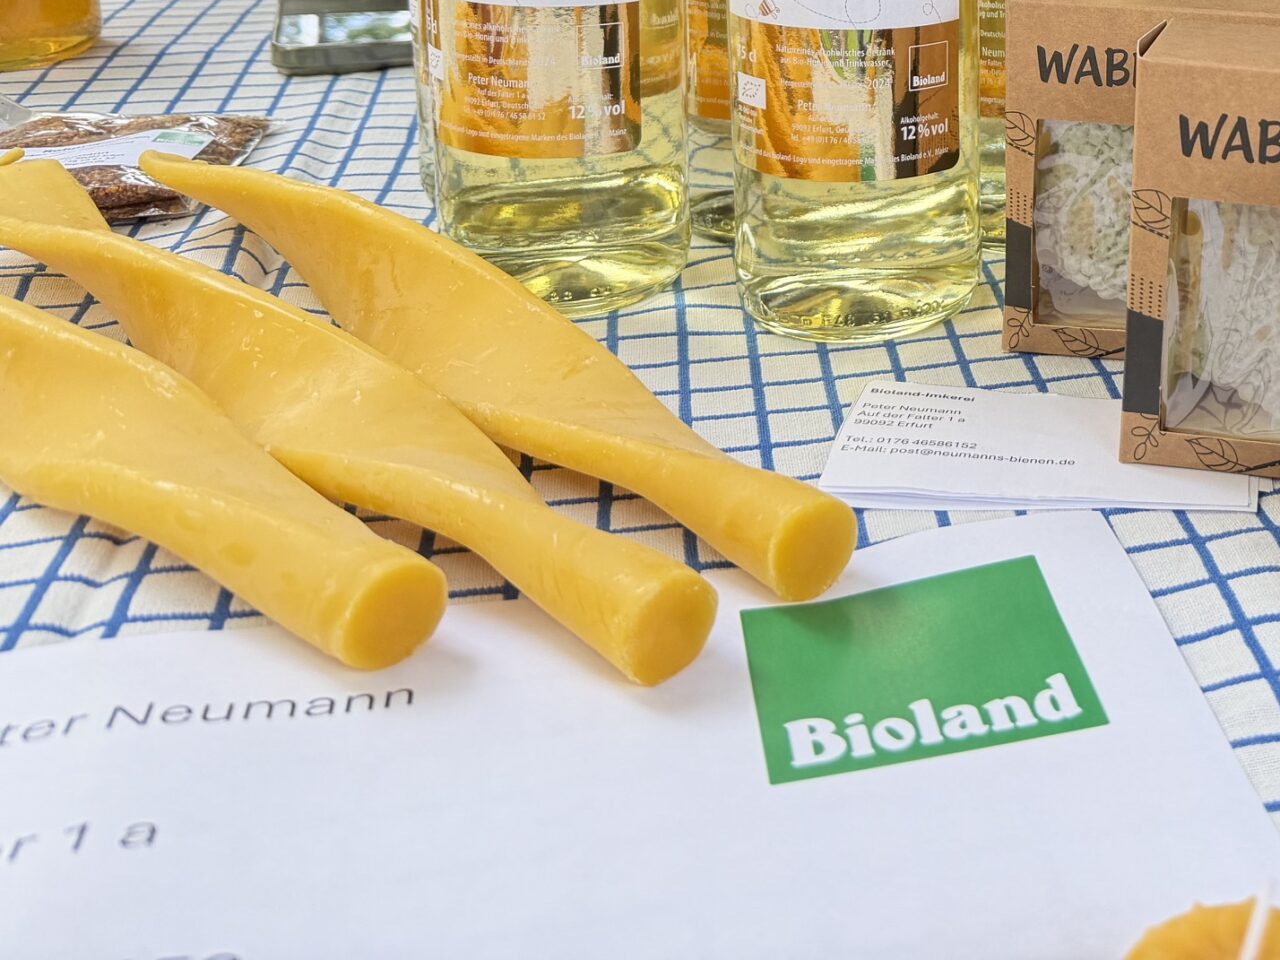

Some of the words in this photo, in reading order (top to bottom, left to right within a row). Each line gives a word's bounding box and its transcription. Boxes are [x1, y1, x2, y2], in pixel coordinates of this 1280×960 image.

[982, 46, 1006, 58] Neum
[1037, 43, 1137, 88] WAB
[468, 72, 489, 86] Peter
[491, 75, 530, 89] Neuman
[911, 71, 946, 88] Bioland
[604, 99, 626, 116] vol
[931, 118, 949, 136] vol
[901, 152, 922, 162] Bioland
[870, 388, 975, 402] Bioland-Imkerei
[857, 409, 880, 417] Auf
[907, 413, 944, 422] Falter
[862, 402, 896, 411] Peter
[899, 404, 962, 415] Neumann
[854, 418, 895, 427] 99092
[897, 420, 934, 429] Erfurt
[845, 435, 874, 443] Tel.:
[876, 437, 910, 446] 0176
[912, 439, 978, 449] 46586152
[840, 444, 887, 453] E-Mail:
[889, 446, 1076, 466] post@neumanns-bienen.de
[105, 687, 416, 732] Neumann
[783, 672, 1083, 768] Bioland
[66, 821, 89, 854] 1
[119, 819, 159, 850] a
